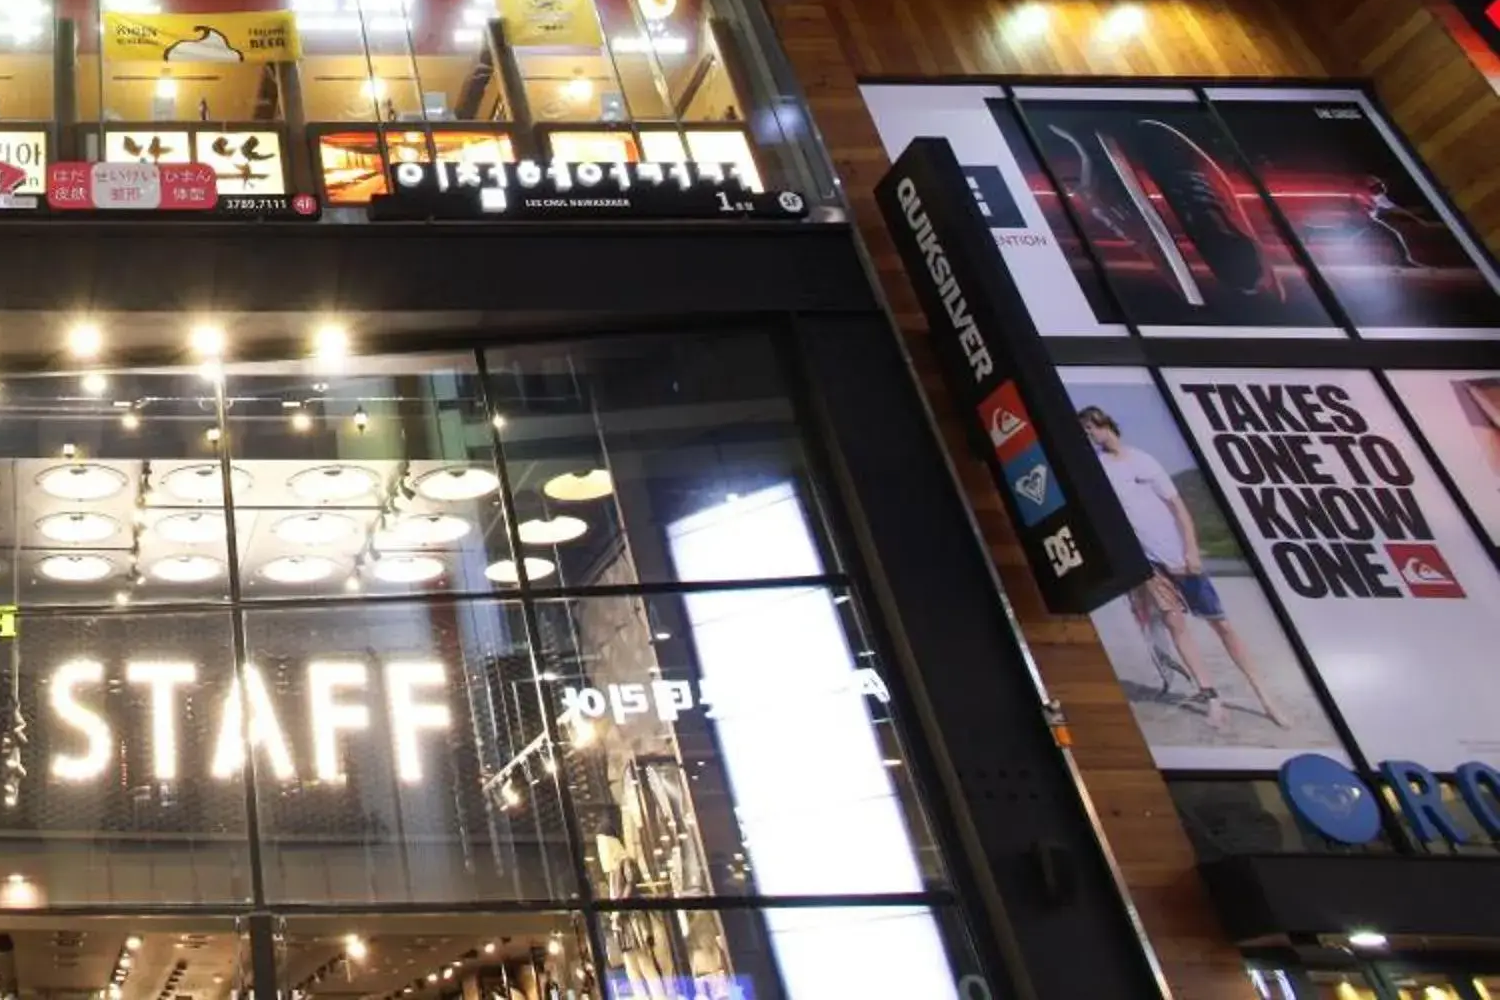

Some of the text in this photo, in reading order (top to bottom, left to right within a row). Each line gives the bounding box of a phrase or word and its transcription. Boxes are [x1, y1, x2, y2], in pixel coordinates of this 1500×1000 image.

[896, 176, 995, 383] QUIKSILVER
[1180, 383, 1368, 434] TAKES
[1212, 433, 1415, 487] ONE TO
[1237, 487, 1436, 541] KNOW
[1271, 541, 1404, 598] ONE
[49, 657, 454, 784] STAFF
